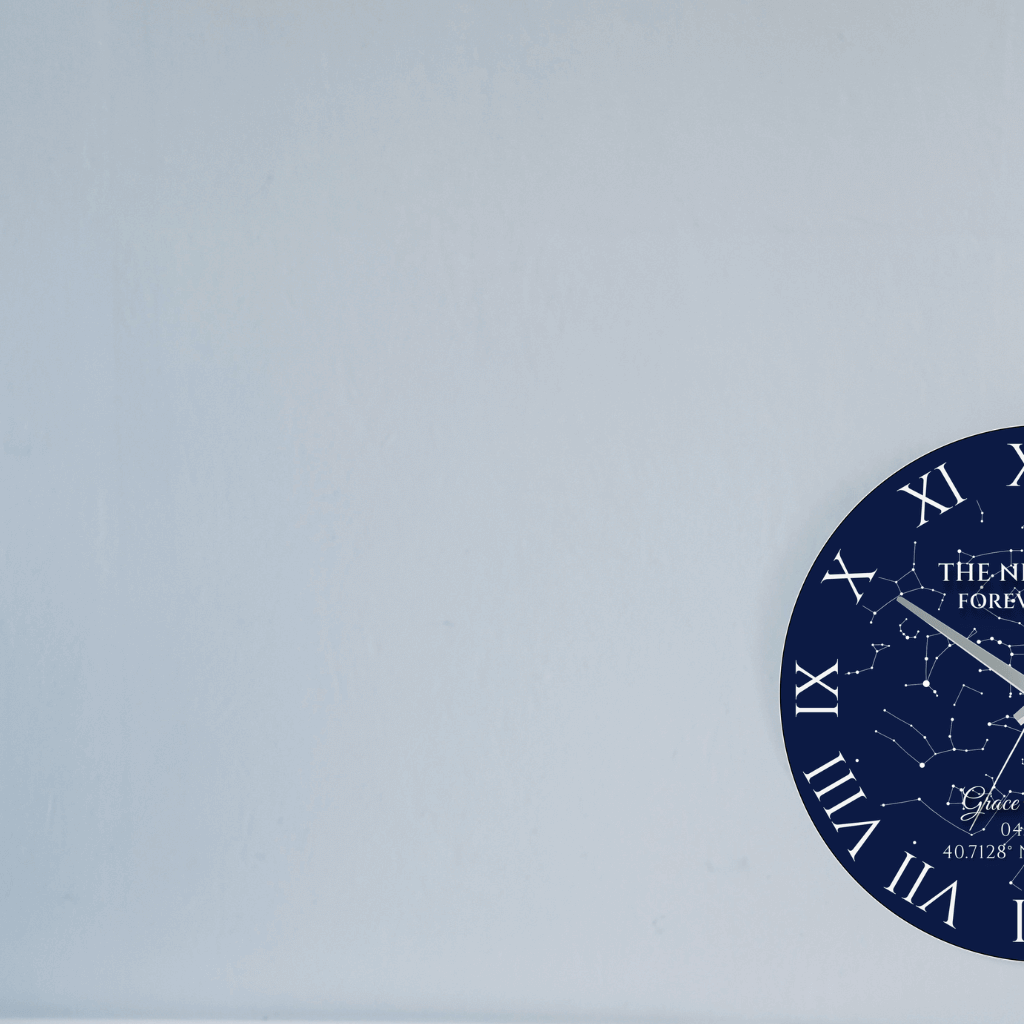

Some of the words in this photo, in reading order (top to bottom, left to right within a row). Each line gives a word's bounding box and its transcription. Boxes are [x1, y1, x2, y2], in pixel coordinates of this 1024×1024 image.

[896, 462, 968, 528] XI
[821, 548, 878, 604] X
[938, 562, 990, 582] THE
[795, 658, 839, 718] IX
[802, 750, 881, 862] VIII
[960, 785, 1020, 822] Grace
[942, 844, 1013, 860] 40.7128°
[883, 850, 958, 929] VII
